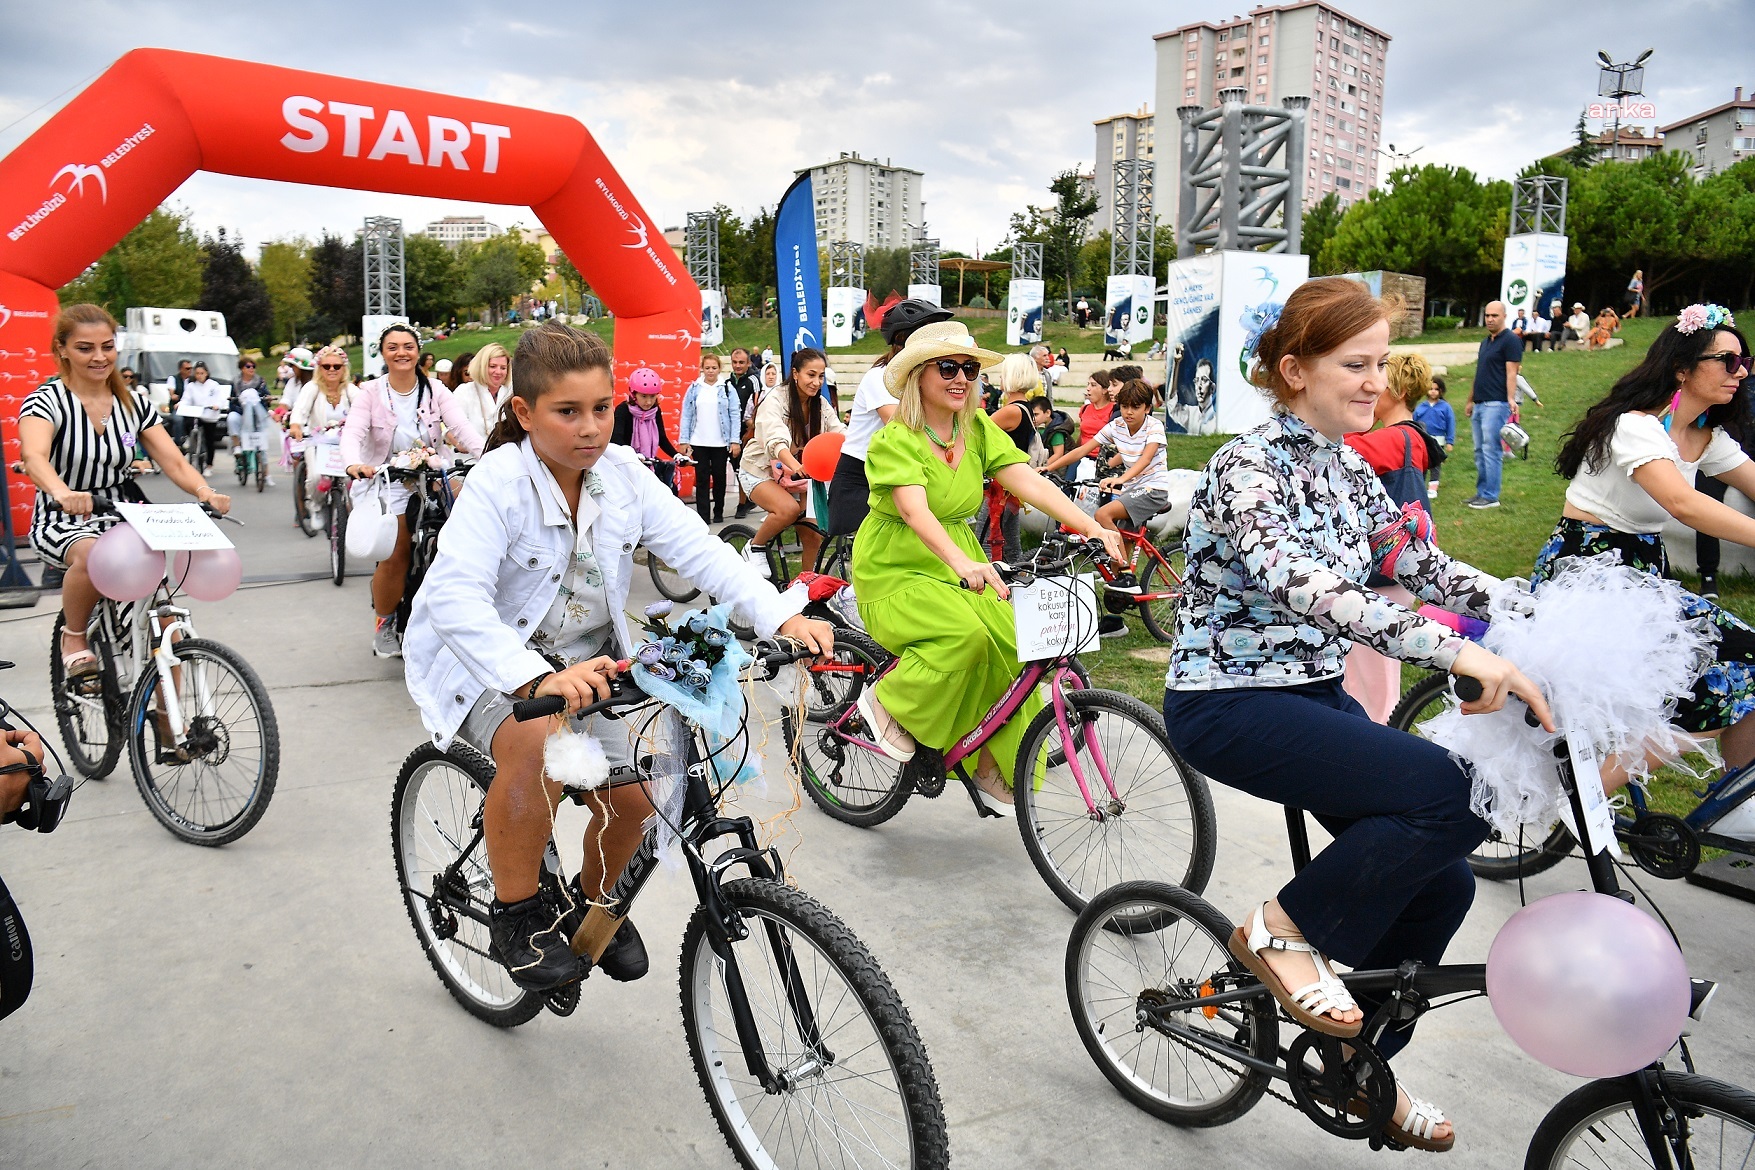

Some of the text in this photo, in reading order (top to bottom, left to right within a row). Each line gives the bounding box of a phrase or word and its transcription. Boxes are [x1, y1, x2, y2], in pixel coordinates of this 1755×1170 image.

[279, 95, 512, 174] START
[7, 122, 157, 242] BEYLİKDÜZÜ BELEDİYESİ
[595, 177, 678, 286] BEYLİKDÜZÜ BELEDİYESİ
[1048, 611, 1066, 620] karşı
[4, 914, 23, 961] Canon
